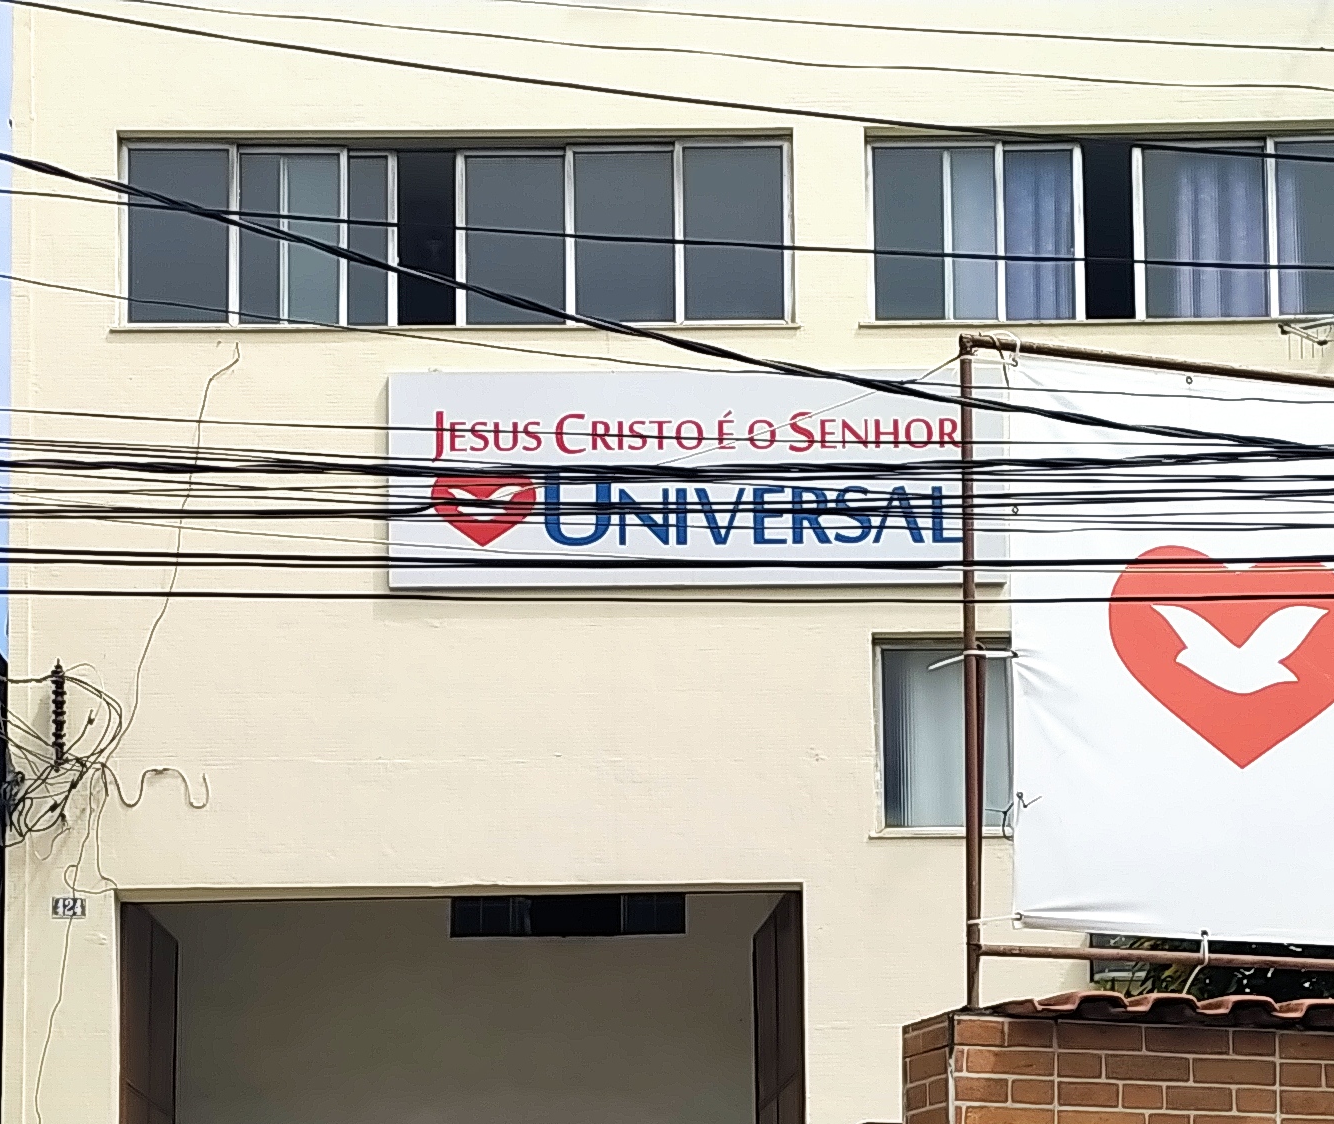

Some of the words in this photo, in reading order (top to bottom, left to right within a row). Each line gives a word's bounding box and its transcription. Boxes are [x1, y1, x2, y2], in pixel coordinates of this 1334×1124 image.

[432, 411, 542, 463] JESUS
[555, 413, 704, 454] CRISTO
[718, 410, 737, 450] É
[748, 419, 777, 450] O
[789, 411, 962, 452] SENHOR
[544, 473, 964, 546] UNIVERSAL
